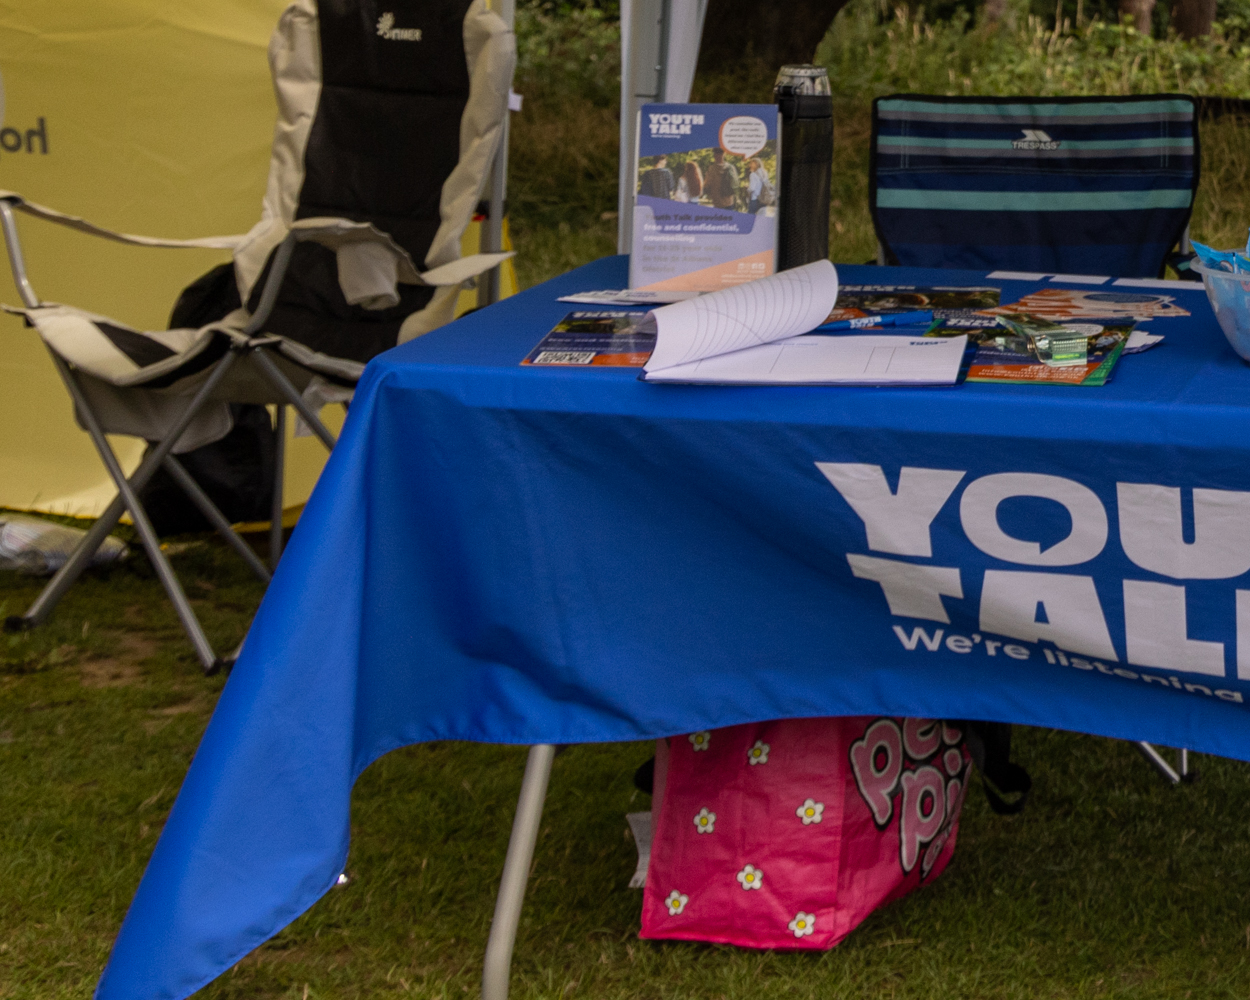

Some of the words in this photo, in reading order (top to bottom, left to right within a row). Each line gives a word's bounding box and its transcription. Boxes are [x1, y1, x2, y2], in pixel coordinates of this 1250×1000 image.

[649, 114, 705, 125] YOUTH
[649, 124, 692, 134] TALK
[1043, 646, 1244, 703] listening
